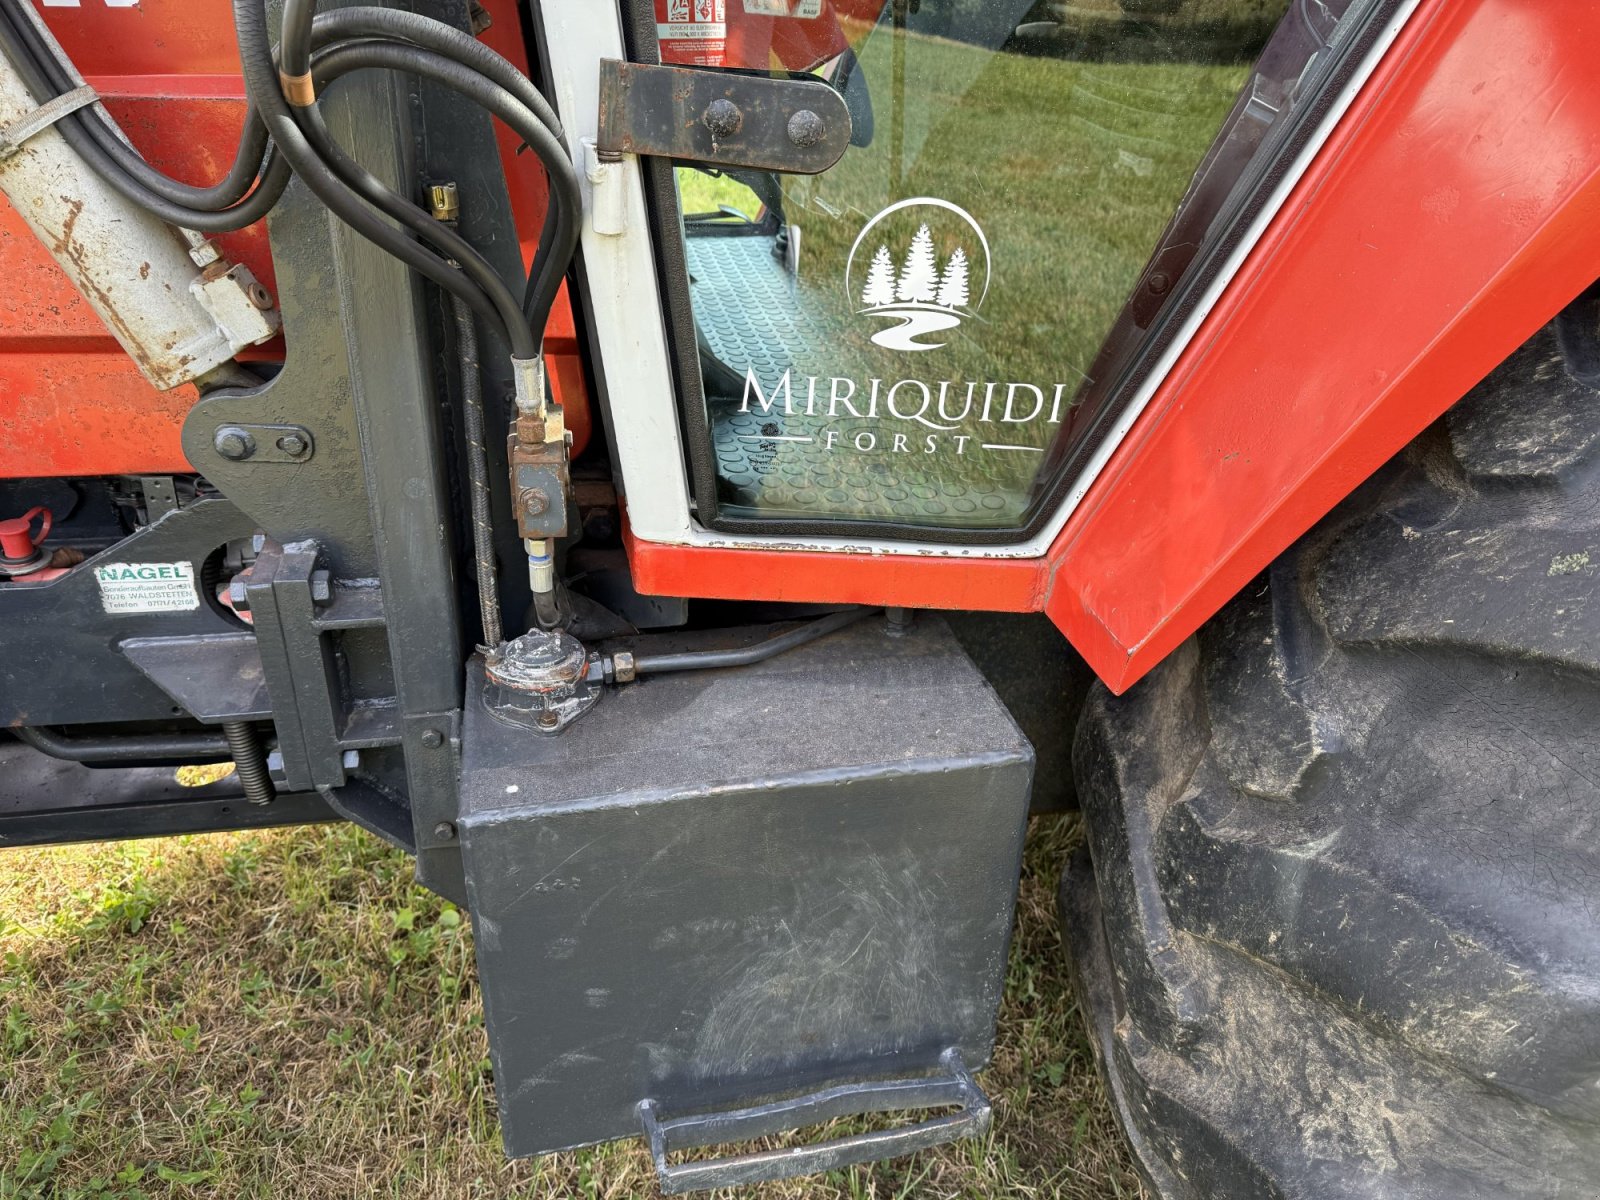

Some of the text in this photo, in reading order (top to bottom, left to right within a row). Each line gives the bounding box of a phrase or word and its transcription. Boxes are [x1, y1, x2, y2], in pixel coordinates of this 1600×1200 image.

[737, 366, 1066, 430] MIRIQUIDI
[825, 431, 970, 454] FORST
[100, 566, 188, 580] NAGEL
[128, 590, 193, 600] WALDSTETTEN
